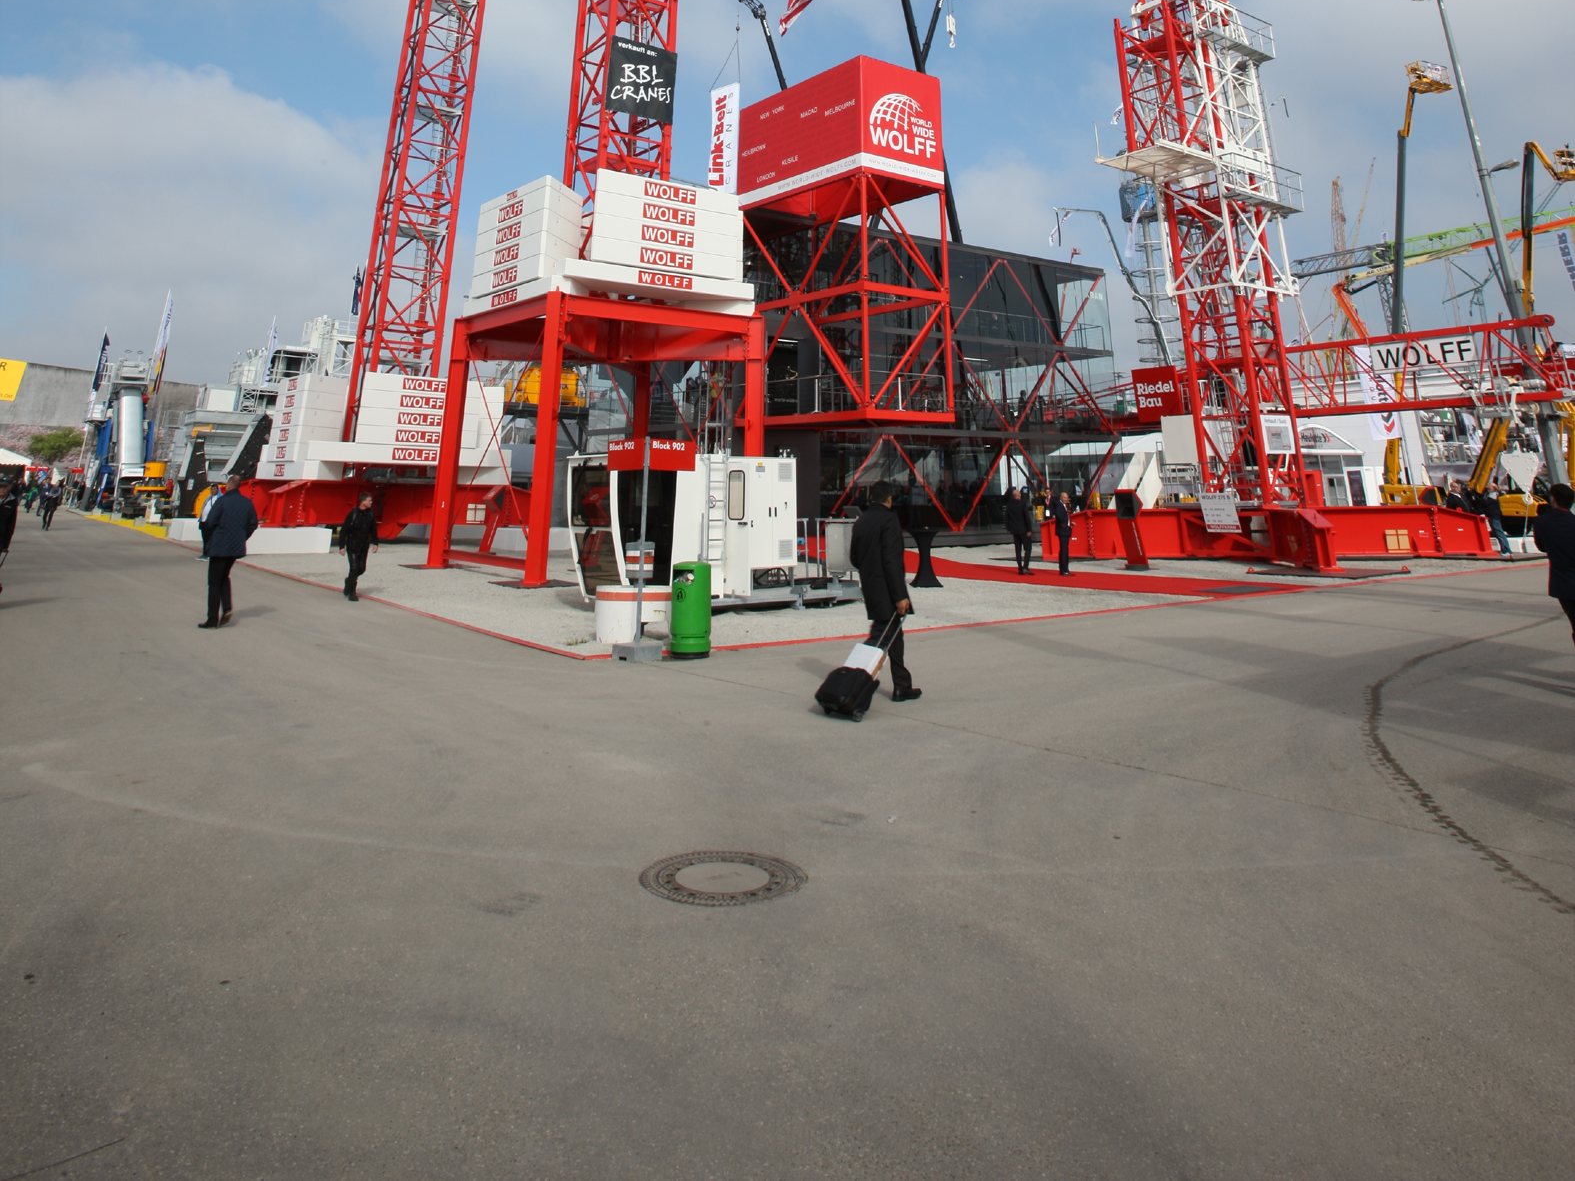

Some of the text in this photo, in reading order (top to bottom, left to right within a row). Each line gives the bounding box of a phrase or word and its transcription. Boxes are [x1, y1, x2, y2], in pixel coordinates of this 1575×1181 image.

[617, 41, 658, 57] verkauft an:
[620, 64, 663, 85] BBL
[610, 85, 672, 104] CRANES
[759, 105, 785, 120] NEW YORK
[800, 107, 818, 119] MACAO
[824, 99, 856, 117] MELBOURNE
[910, 116, 932, 128] WORLD
[725, 92, 733, 185] CRANES
[911, 124, 935, 139] WIDE
[709, 94, 727, 186] Link-Belt
[870, 124, 936, 159] WOLFF
[741, 143, 766, 158] HEILBRONN
[756, 171, 776, 183] LONDON
[646, 182, 695, 203] WOLFF
[499, 202, 523, 223] WOLFF
[645, 204, 694, 225] WOLFF
[497, 224, 521, 244] WOLFF
[643, 226, 693, 246] WOLFF
[495, 245, 519, 266] WOLFF
[642, 248, 692, 268] WOLFF
[493, 268, 517, 288] WOLFF
[641, 273, 689, 288] WOLFF
[493, 290, 517, 306] WOLFF
[1377, 339, 1472, 369] WOLFF
[405, 379, 446, 392] WOLFF
[1136, 380, 1175, 396] Riedel
[402, 396, 443, 409] WOLFF
[1139, 396, 1163, 408] Bau
[399, 413, 441, 426] WOLFF
[397, 431, 439, 443] WOLFF
[609, 441, 635, 451] Block 902
[652, 440, 685, 451] Block 902
[394, 449, 436, 461] WOLFF
